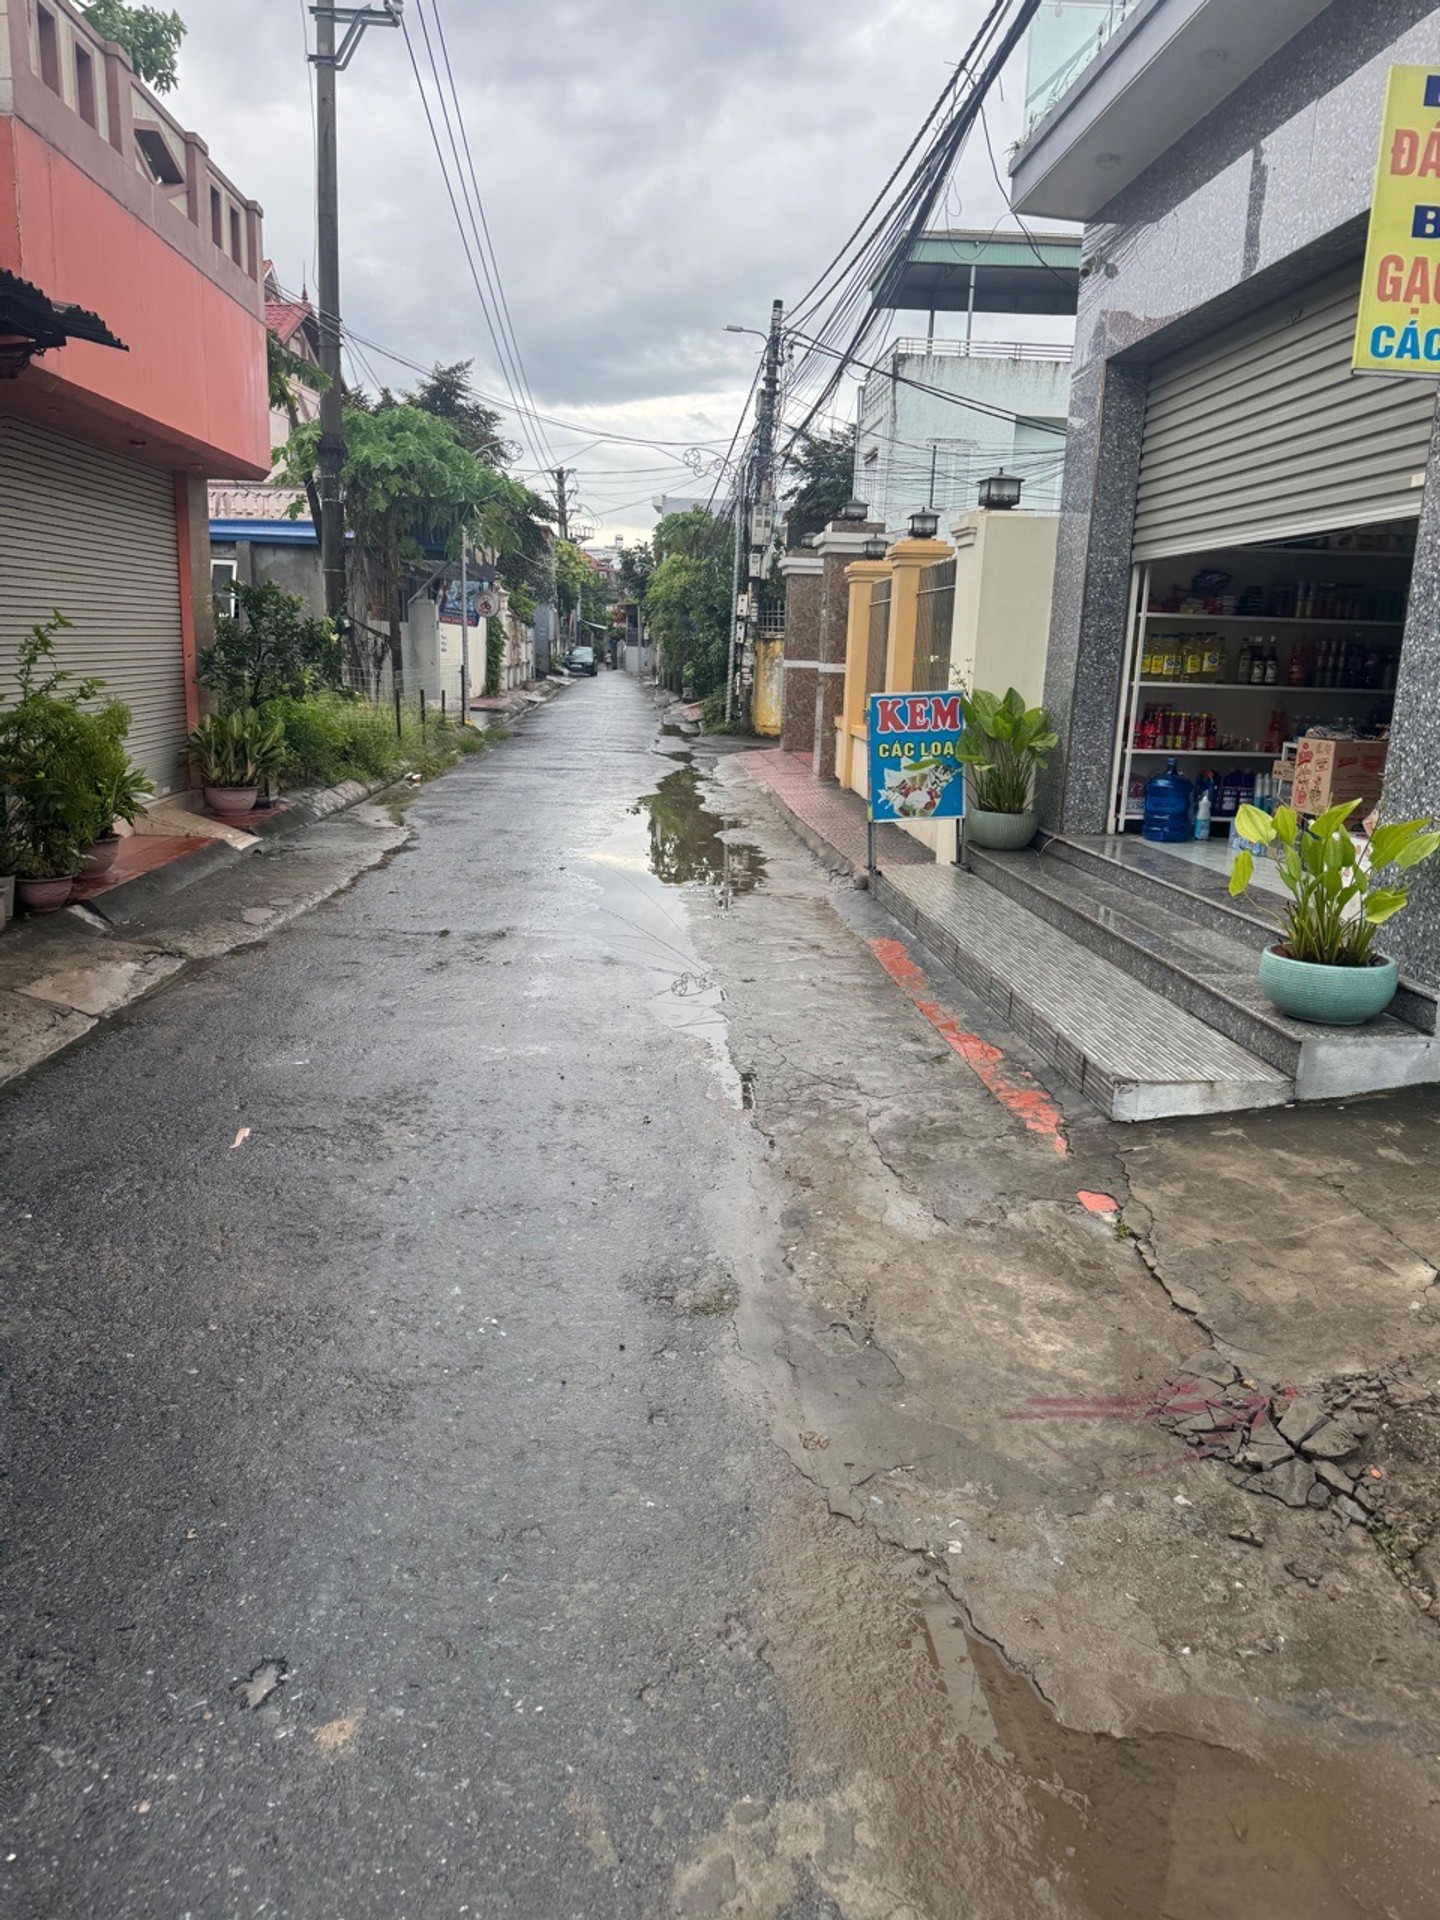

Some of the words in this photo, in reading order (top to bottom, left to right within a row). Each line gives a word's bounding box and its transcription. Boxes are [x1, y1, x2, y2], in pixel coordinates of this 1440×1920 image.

[1377, 254, 1440, 314] GẠ
[1370, 320, 1440, 361] CÁC
[877, 697, 961, 733] KEM
[879, 740, 915, 757] CÁC
[920, 742, 958, 758] LOẠ
